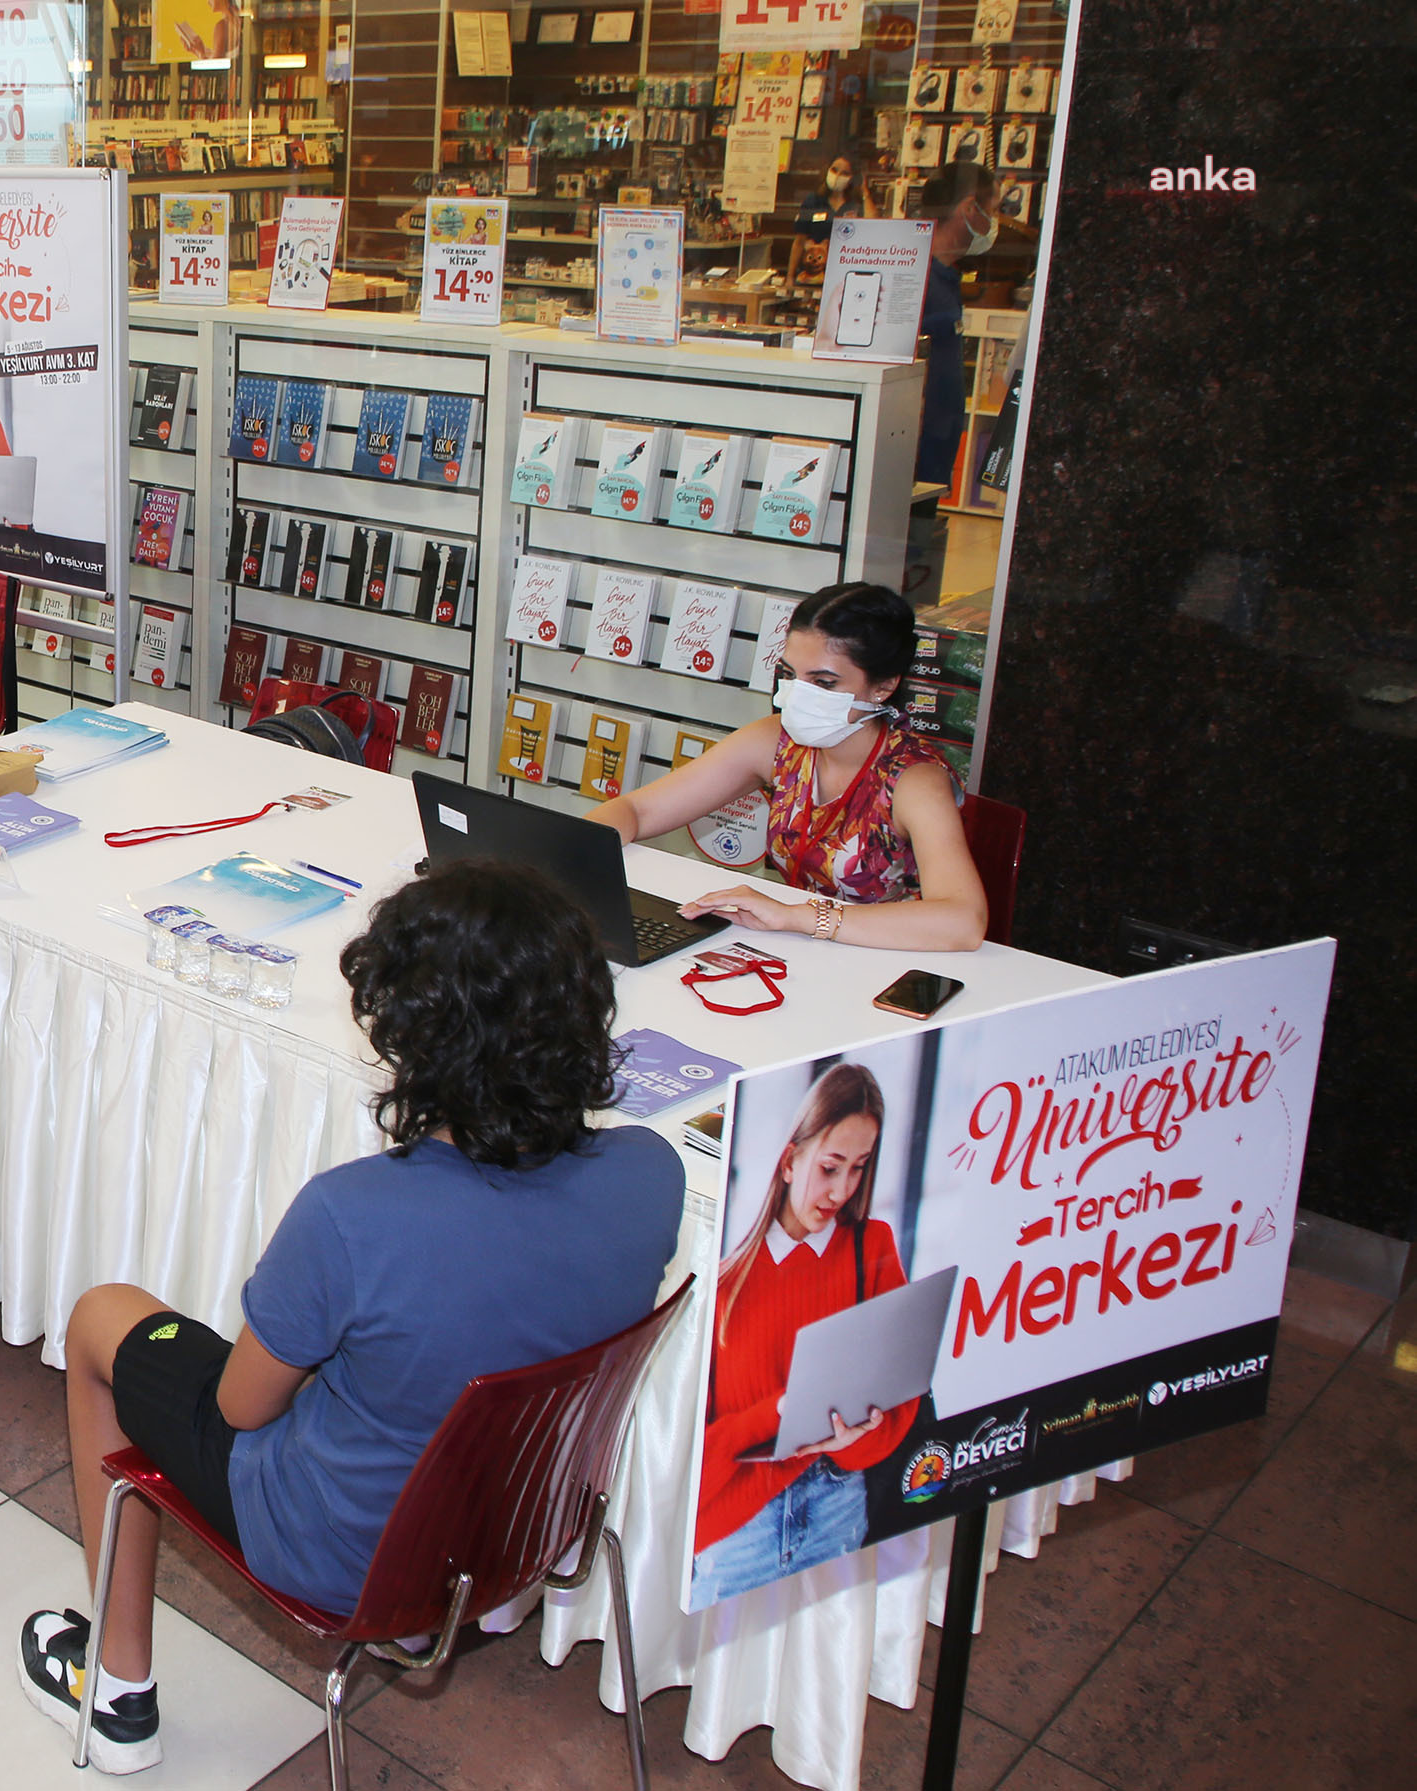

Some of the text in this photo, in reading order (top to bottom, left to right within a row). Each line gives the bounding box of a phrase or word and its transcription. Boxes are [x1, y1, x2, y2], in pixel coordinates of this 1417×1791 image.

[758, 85, 782, 94] KİTAP
[182, 245, 207, 254] KİTAP
[839, 244, 918, 257] Aradığınız Ürünü
[449, 255, 478, 266] KİTAP
[839, 256, 916, 267] Bulamadınız mı?
[0, 351, 95, 375] YEŞİLYURT AVM 3. KAT
[41, 374, 58, 385] 13:00
[63, 373, 81, 384] 22:00
[516, 471, 534, 483] Çılgın
[598, 482, 618, 494] Çılgın
[146, 492, 177, 505] EVRENİ
[676, 492, 695, 503] Çılgın
[149, 503, 171, 513] YUTAN
[762, 501, 811, 514] Çılgın Fikirler
[144, 511, 174, 525] ÇOCUK
[54, 555, 104, 572] YEŞİLYURT
[535, 562, 562, 573] ROWLING
[526, 571, 554, 592] Güzel
[616, 577, 644, 587] ROWLING
[607, 586, 635, 608] Güzel
[696, 587, 726, 600] ROWLING
[683, 598, 718, 619] Güzel
[144, 623, 166, 636] pan-
[143, 634, 167, 649] demi
[235, 651, 257, 666] SOH
[234, 664, 254, 676] BET
[292, 663, 313, 677] SOH
[349, 679, 371, 693] SOH
[418, 692, 441, 709] SOH
[418, 706, 438, 720] BET
[416, 717, 435, 731] LER
[737, 801, 754, 810] Size
[2, 821, 38, 833] ALTIN
[739, 821, 757, 831] Servisi
[1054, 1014, 1223, 1087] ATAKUM BELEDİYESİ
[642, 1071, 692, 1092] ALTIN
[969, 1036, 1276, 1190] Üniversite
[1054, 1170, 1166, 1238] Tercih
[952, 1200, 1243, 1359] Merkezi
[149, 1323, 179, 1341] adidas
[1168, 1354, 1269, 1396] YEŞİLYURT
[953, 1426, 1027, 1470] DEVECİ
